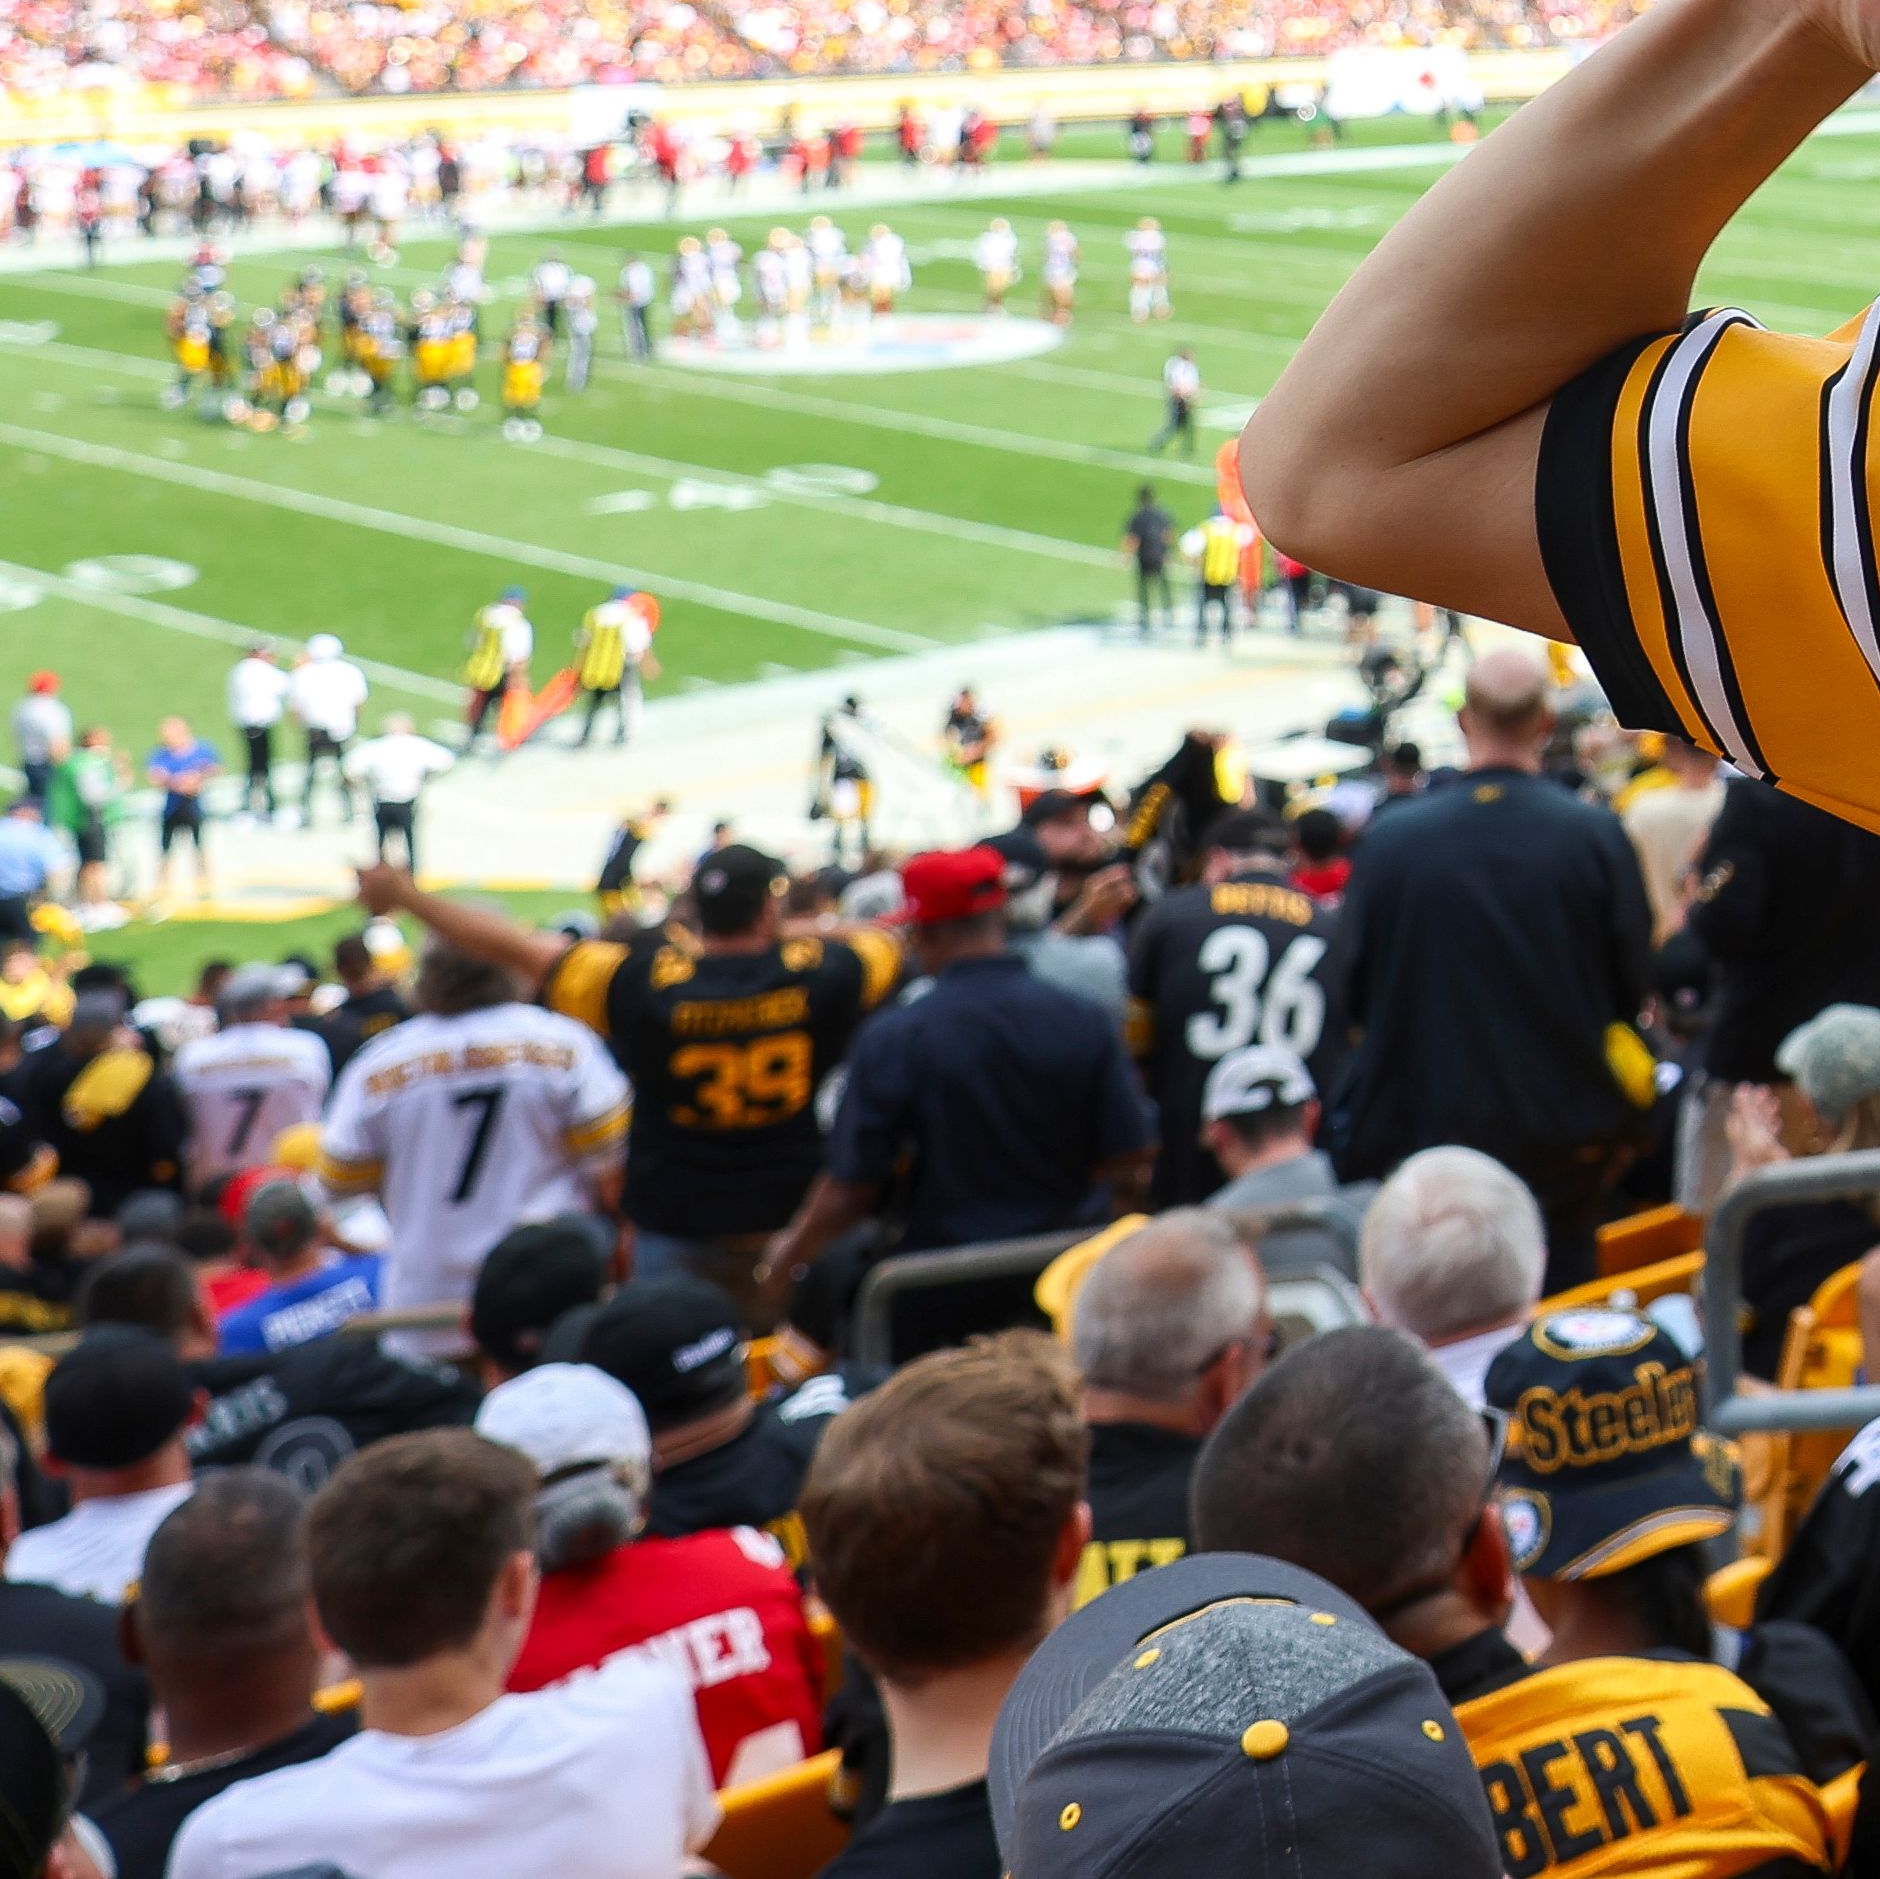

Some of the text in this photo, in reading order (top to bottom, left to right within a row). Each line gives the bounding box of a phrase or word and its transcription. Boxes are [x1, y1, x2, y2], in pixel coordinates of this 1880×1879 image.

[1184, 924, 1329, 1062] 36
[668, 1029, 816, 1131] 39
[453, 1085, 507, 1204] 7
[1478, 1714, 1693, 1879] BERT
